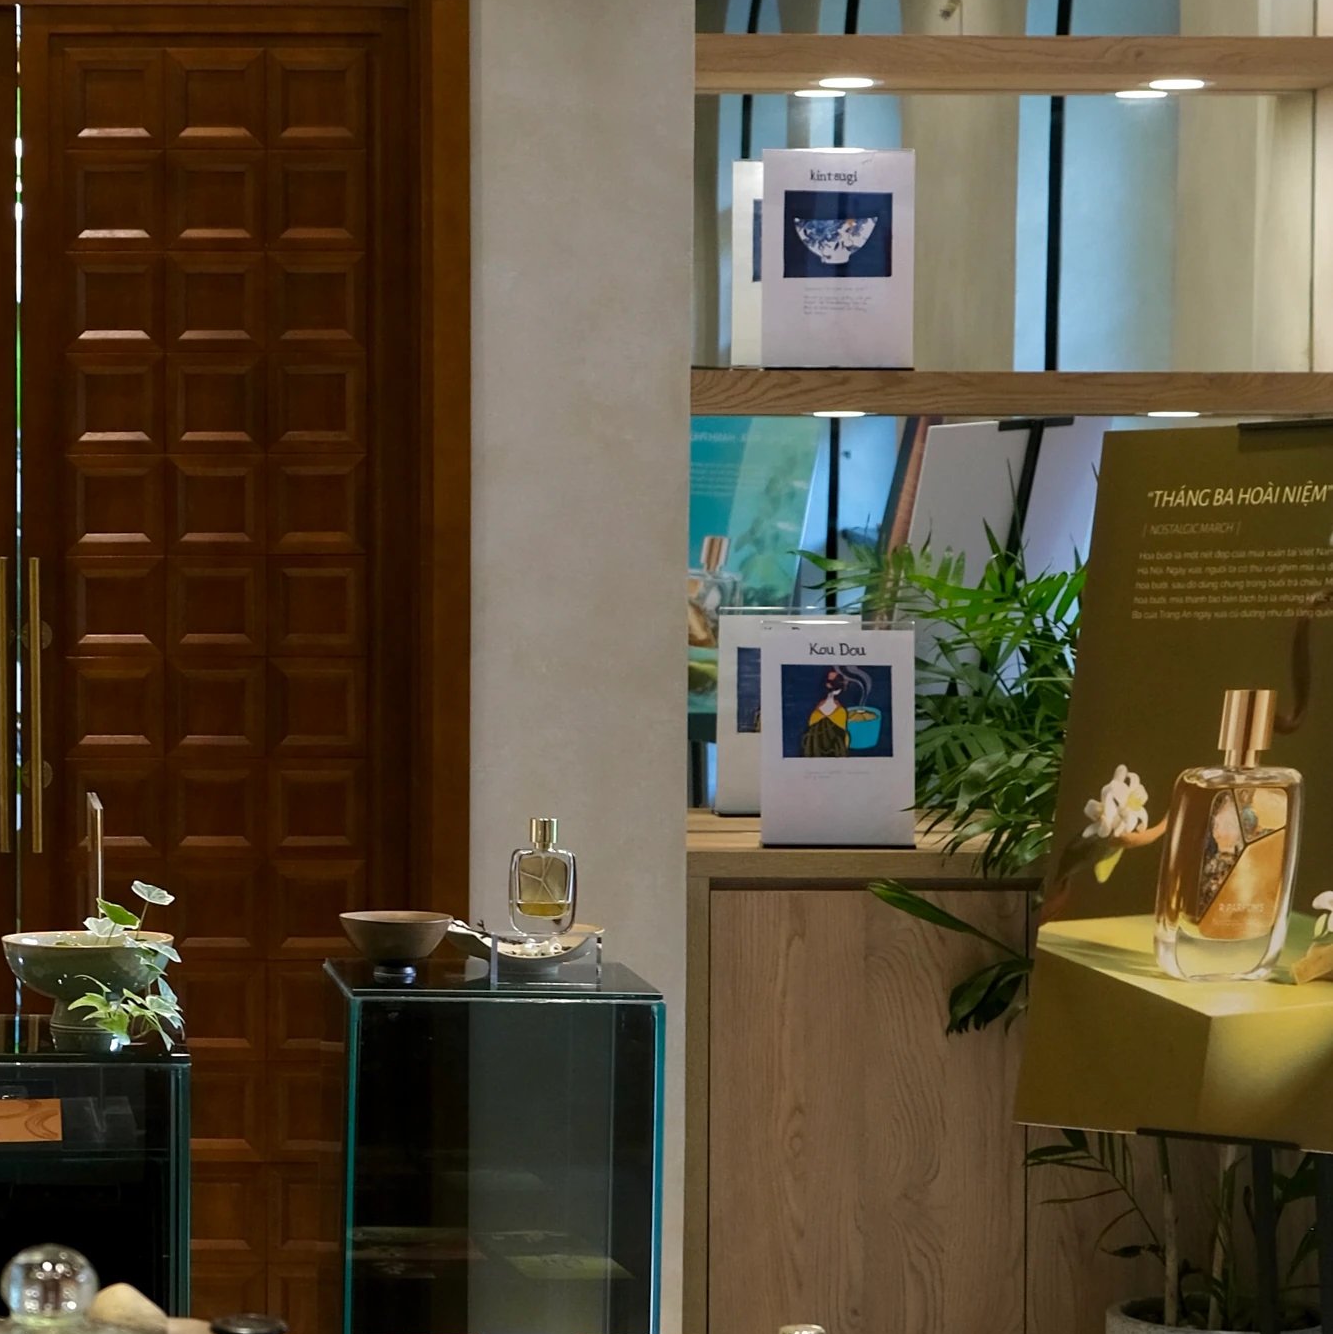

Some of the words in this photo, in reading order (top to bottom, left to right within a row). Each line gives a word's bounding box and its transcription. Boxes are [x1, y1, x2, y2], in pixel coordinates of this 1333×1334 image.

[1213, 488, 1234, 507] BA
[1237, 481, 1279, 506] HOÀI
[809, 643, 835, 655] Kou
[840, 643, 866, 656] Dou
